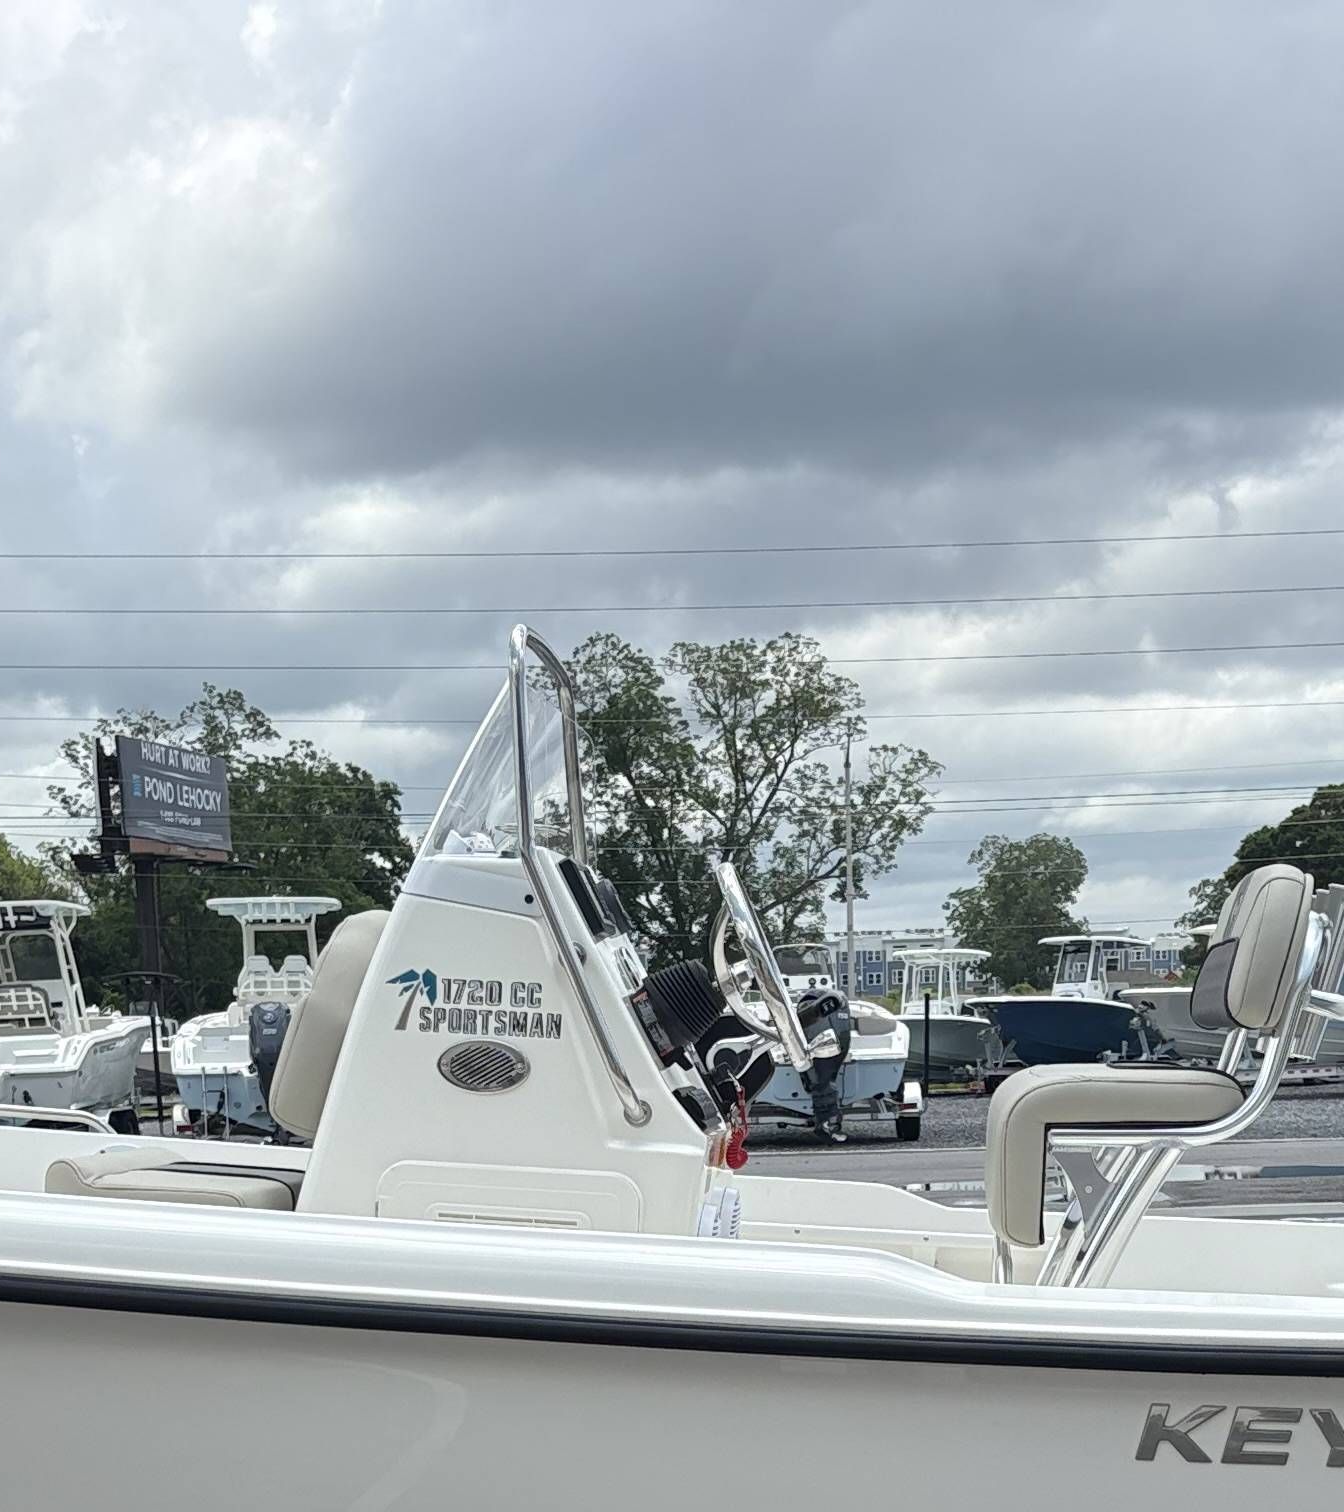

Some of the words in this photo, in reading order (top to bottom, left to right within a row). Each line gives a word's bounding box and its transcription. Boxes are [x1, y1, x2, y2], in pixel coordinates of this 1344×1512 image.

[141, 741, 166, 765] HURT
[168, 748, 179, 769] AT
[181, 751, 211, 774] WORK?
[144, 775, 175, 804] POND
[176, 783, 222, 812] LEHOCKY
[441, 978, 503, 1007] 1720
[510, 981, 543, 1009] CC
[419, 1006, 563, 1040] SPORTSMAN
